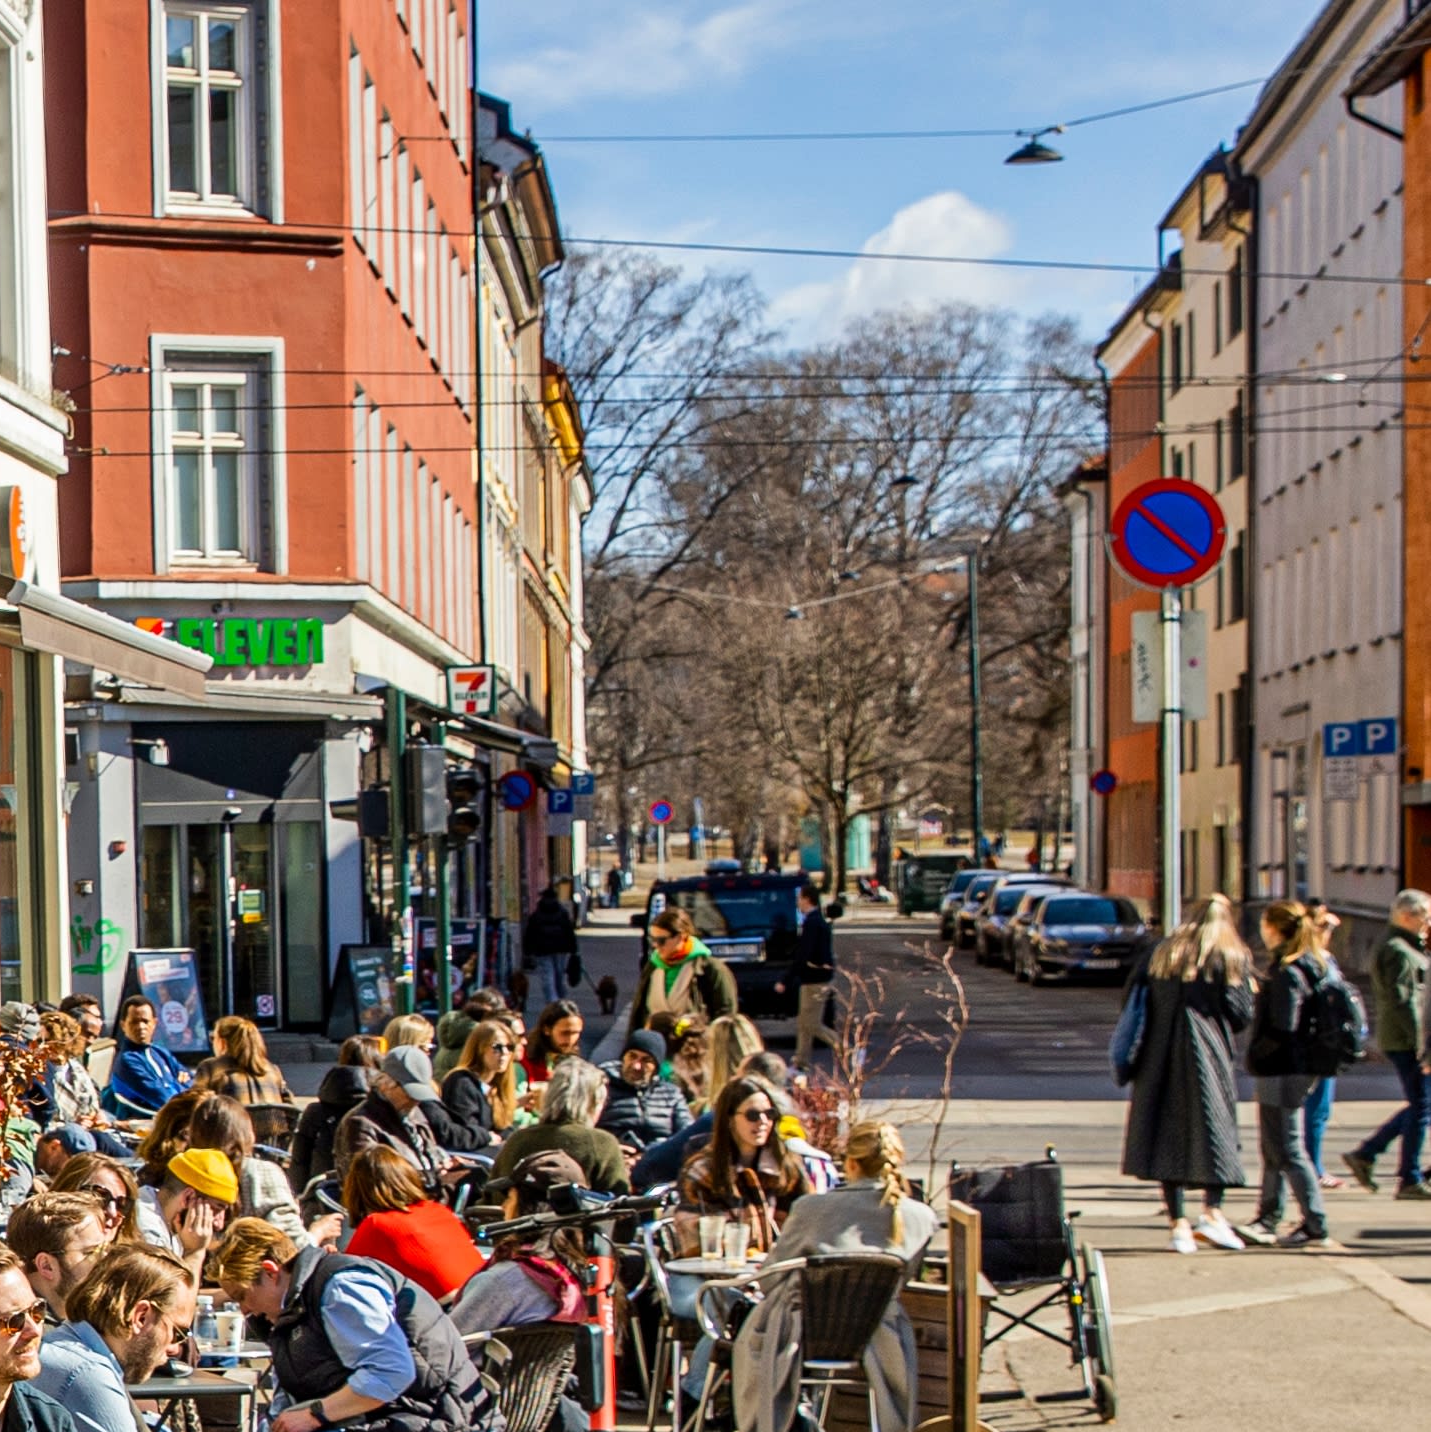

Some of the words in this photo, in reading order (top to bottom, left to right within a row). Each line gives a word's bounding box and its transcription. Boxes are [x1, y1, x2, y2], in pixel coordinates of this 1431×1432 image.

[1332, 727, 1352, 752] P
[1366, 723, 1388, 750] P
[553, 792, 568, 810] P
